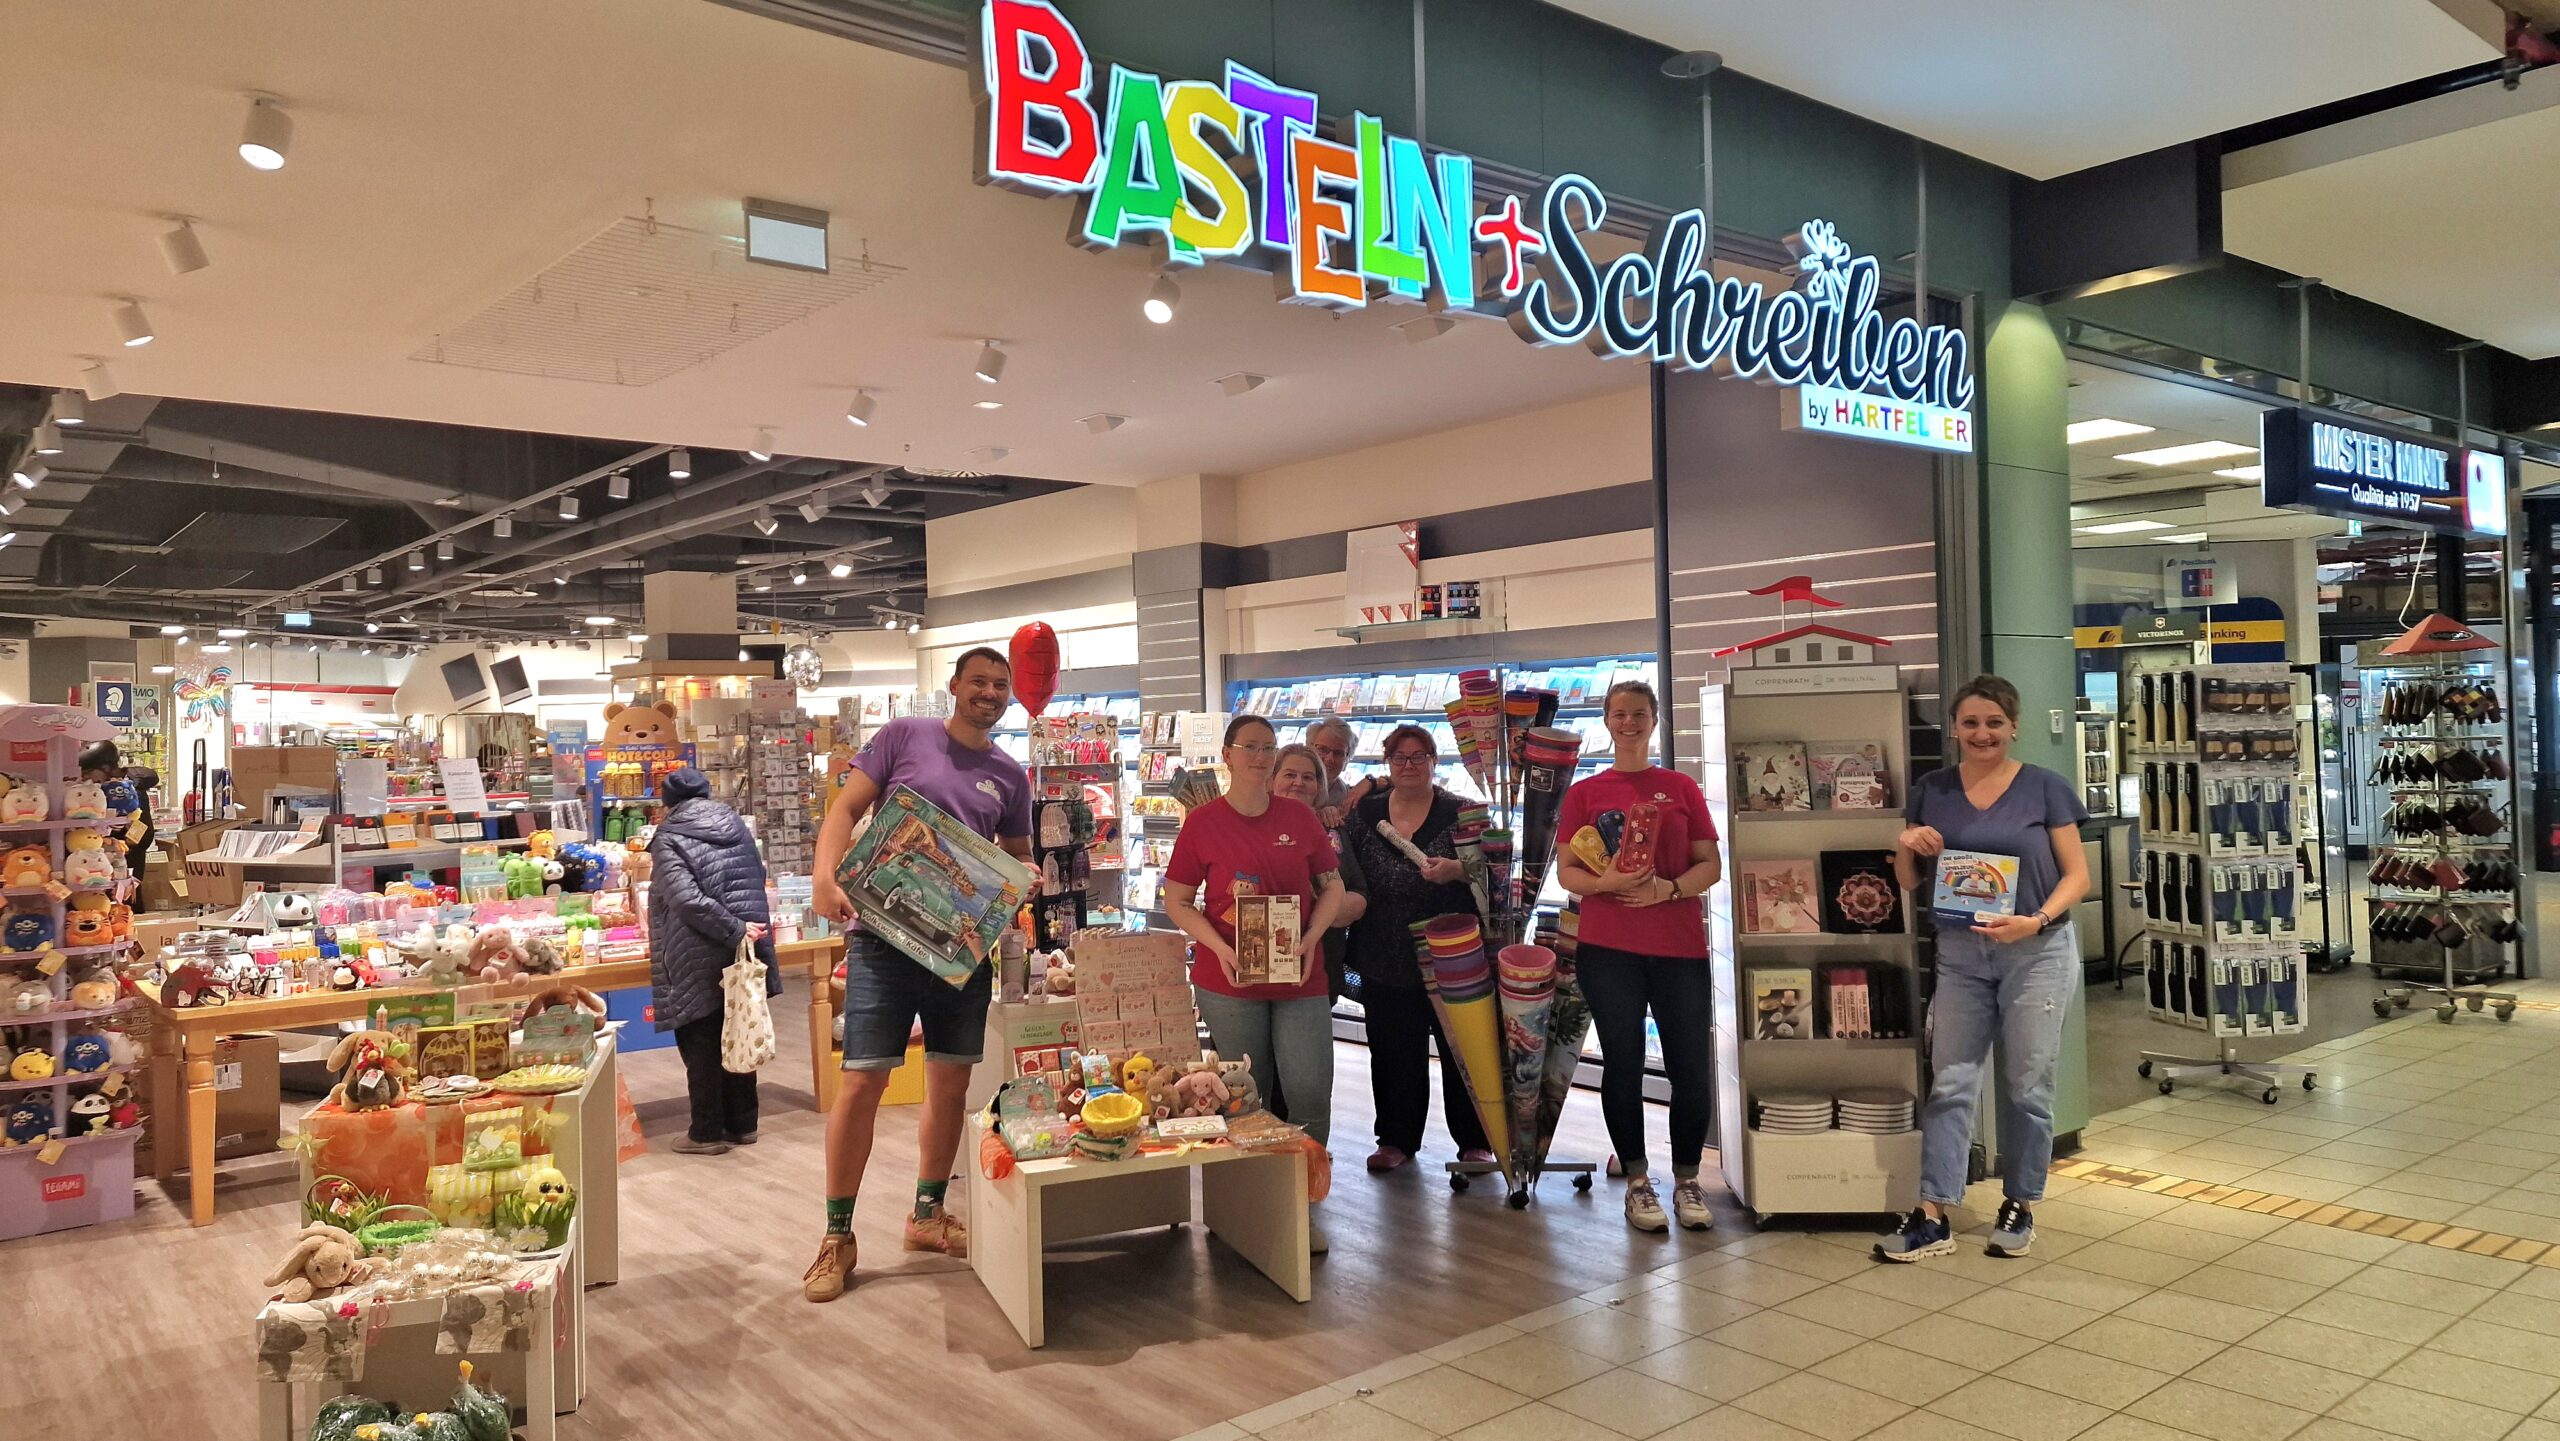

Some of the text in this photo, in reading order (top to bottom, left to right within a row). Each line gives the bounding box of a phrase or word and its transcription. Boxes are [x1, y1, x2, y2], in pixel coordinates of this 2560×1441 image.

[981, 0, 1474, 308] BASTELN
[1524, 174, 1974, 410] Schreiben
[1808, 398, 1969, 443] by HARTFELER
[2312, 421, 2395, 481] MISTER
[2351, 483, 2421, 514] Qualität seit 1957
[2137, 629, 2185, 639] VICTORINOX
[1755, 678, 1810, 686] COPPENRATH
